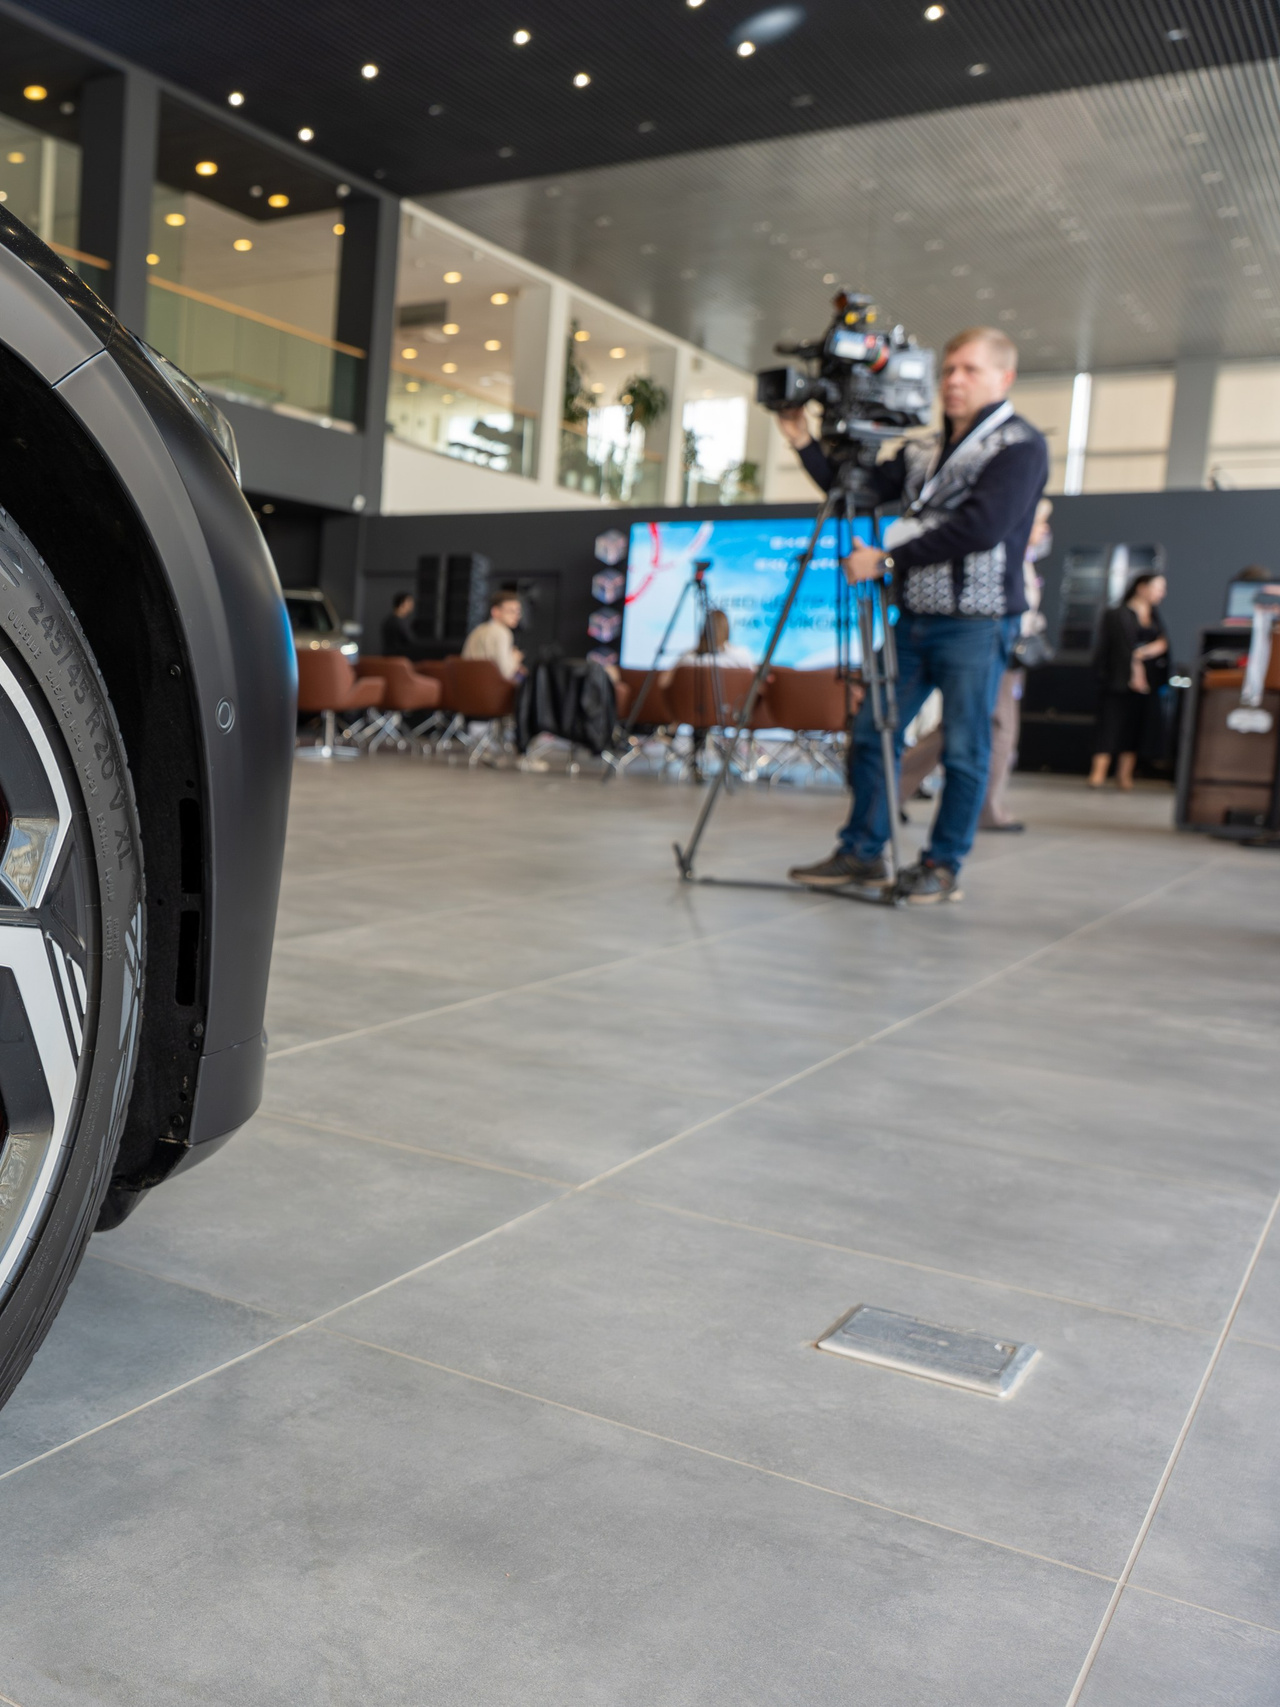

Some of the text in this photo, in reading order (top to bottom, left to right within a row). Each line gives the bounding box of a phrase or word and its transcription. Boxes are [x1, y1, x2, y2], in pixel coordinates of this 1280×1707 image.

[7, 607, 42, 660] OUTSIDE
[28, 592, 133, 871] 245/45 R 20 V XL
